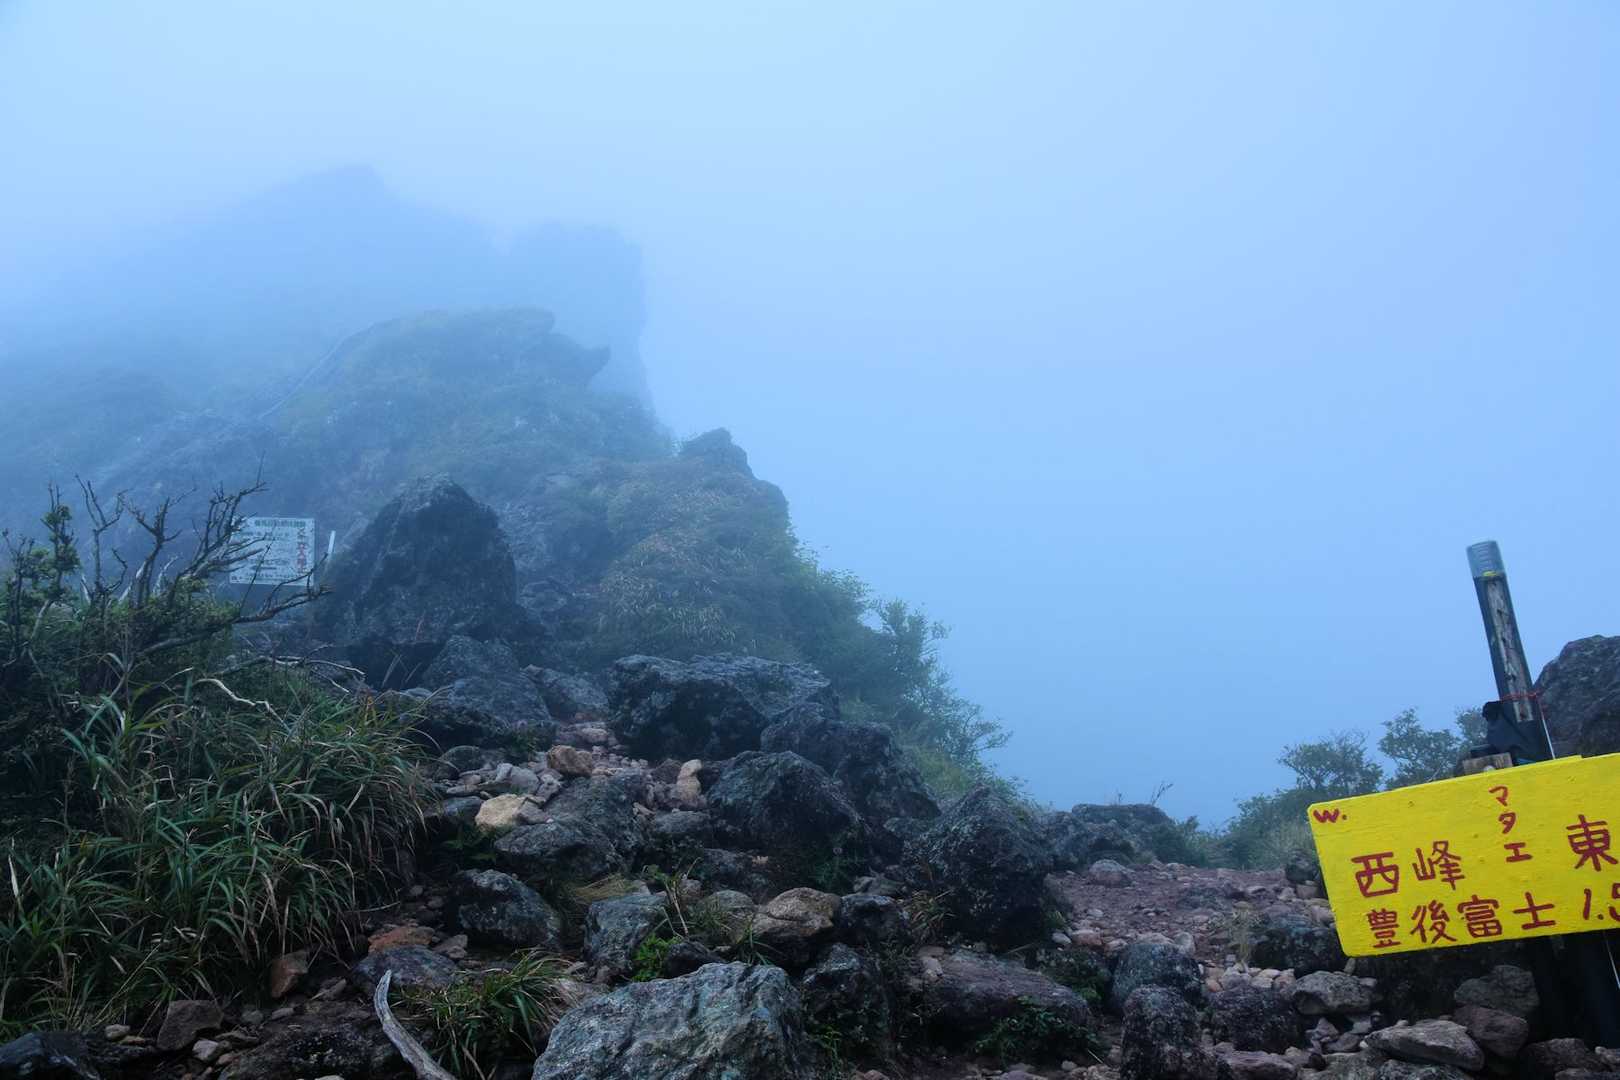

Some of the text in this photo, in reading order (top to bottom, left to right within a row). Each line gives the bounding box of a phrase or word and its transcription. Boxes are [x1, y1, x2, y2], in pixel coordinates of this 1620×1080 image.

[1489, 785, 1533, 862] マタエ
[1566, 814, 1618, 872] 東
[1351, 840, 1466, 898] 西峰
[1366, 891, 1556, 949] 豊後富士
